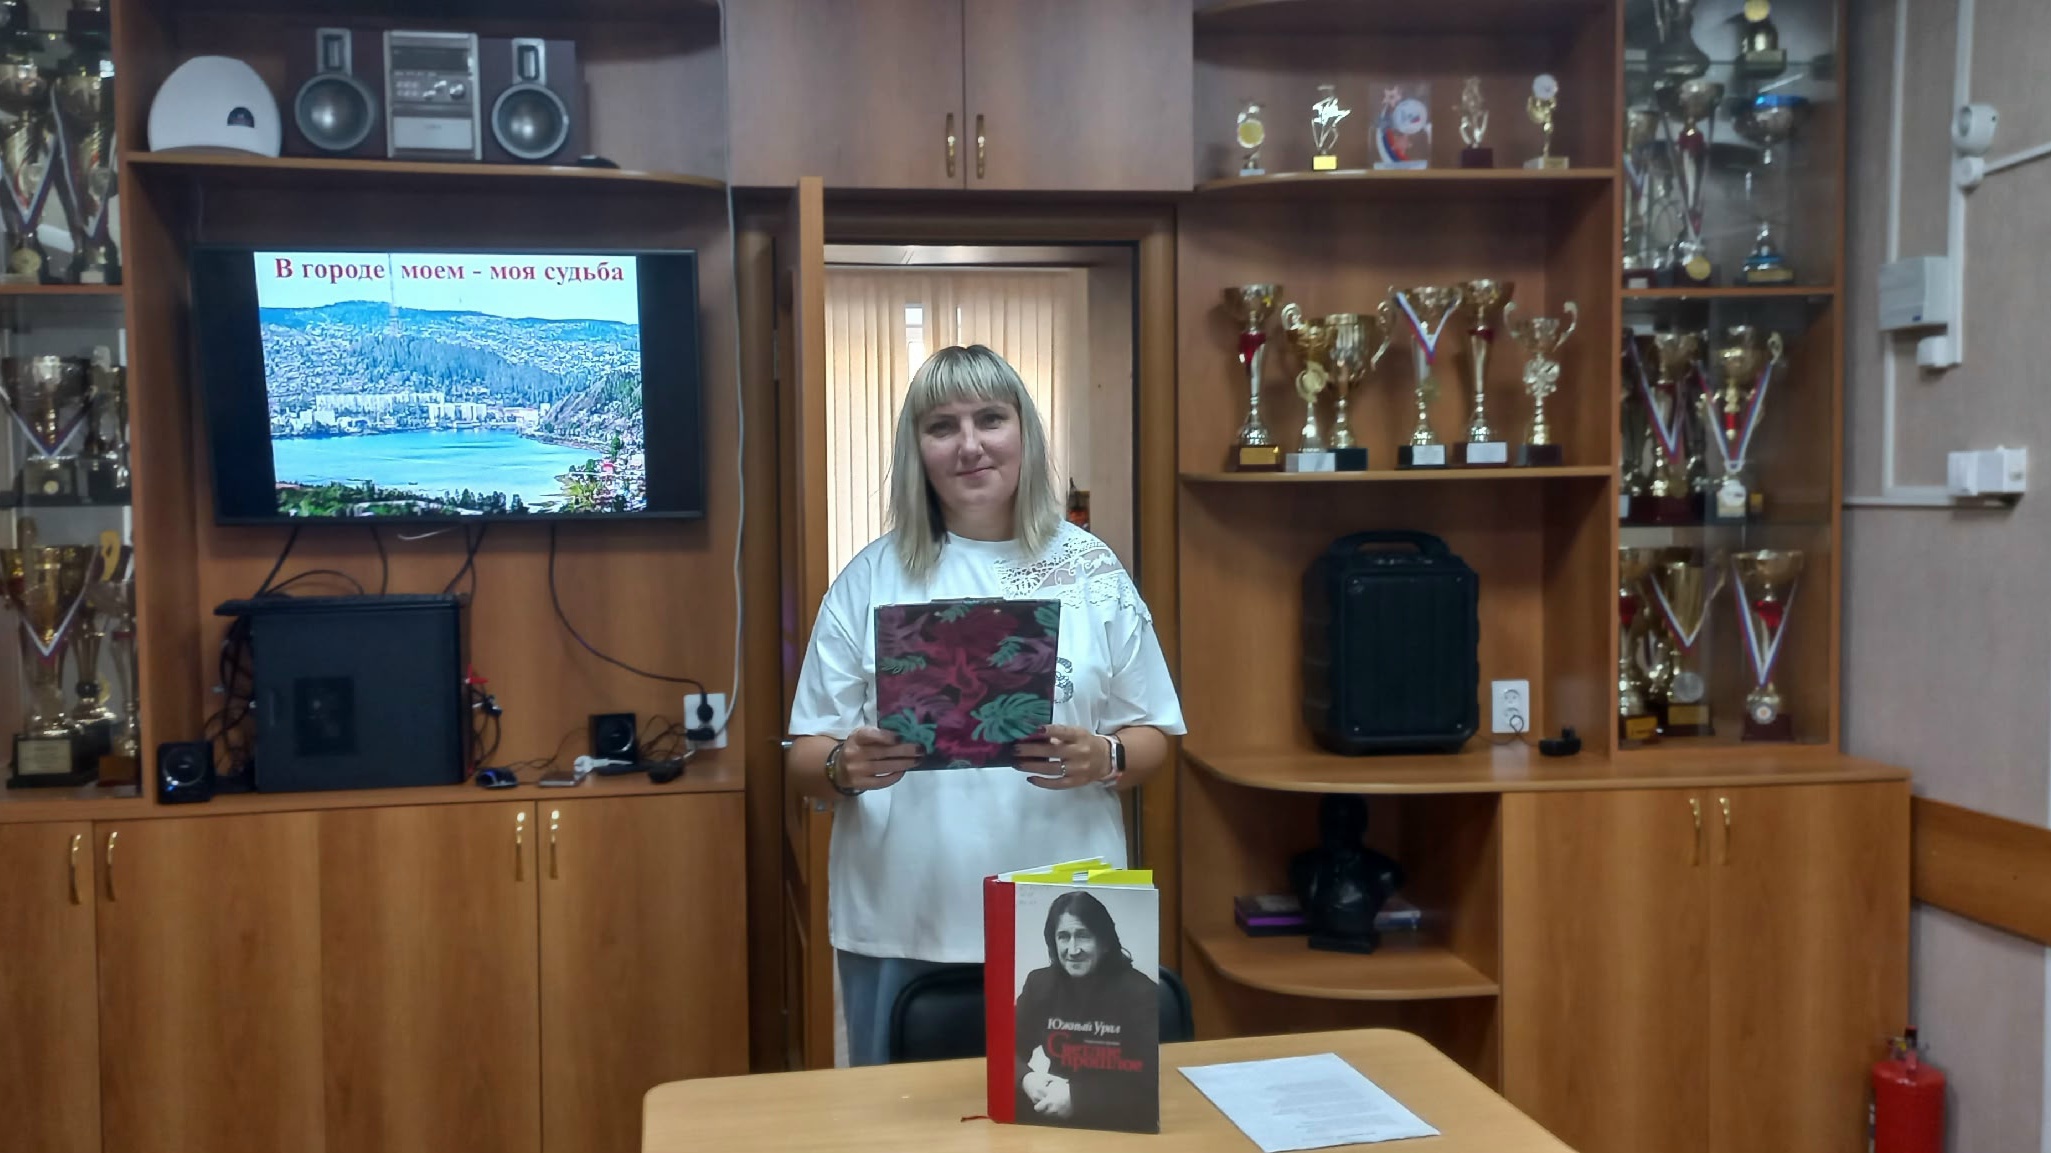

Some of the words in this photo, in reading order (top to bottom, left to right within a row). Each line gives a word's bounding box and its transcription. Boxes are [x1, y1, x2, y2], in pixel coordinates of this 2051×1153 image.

[275, 258, 293, 278] В
[302, 263, 385, 284] городе
[401, 265, 465, 279] моем
[490, 266, 536, 280] моя
[544, 262, 624, 285] судьба
[1047, 1018, 1092, 1032] Южный
[1094, 1020, 1121, 1036] Урал
